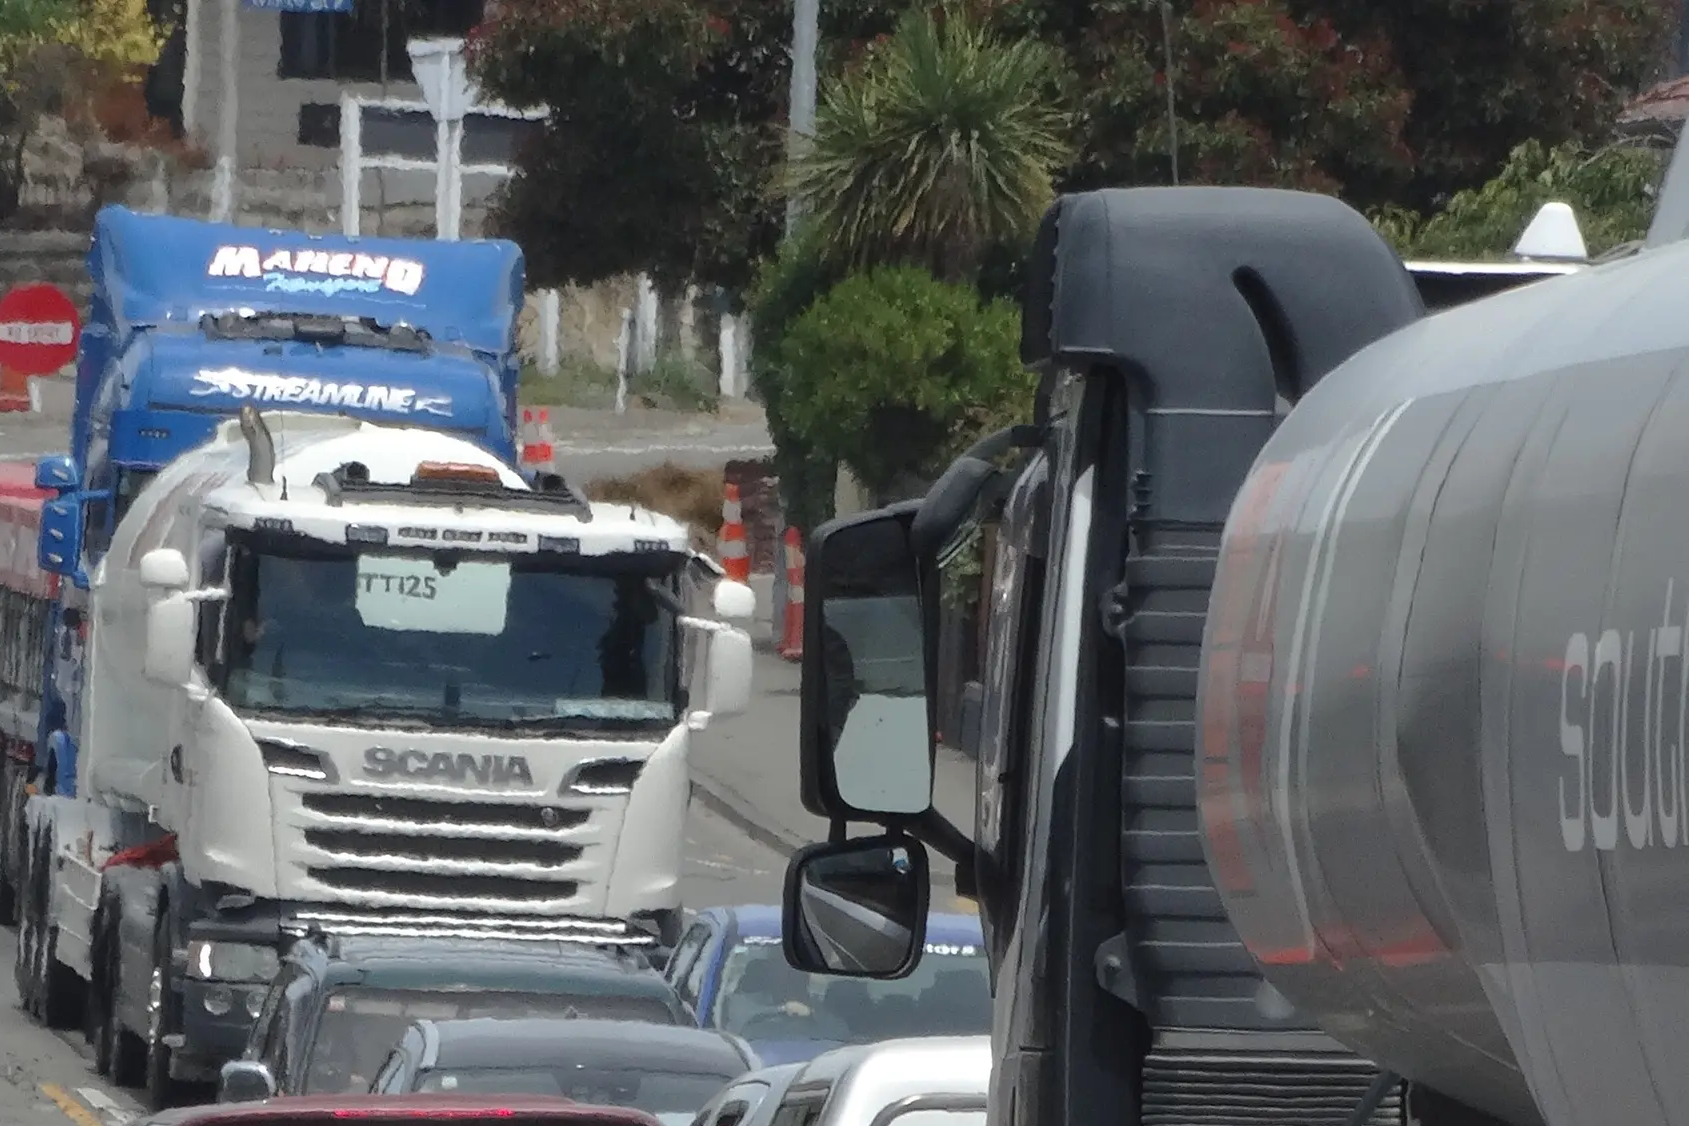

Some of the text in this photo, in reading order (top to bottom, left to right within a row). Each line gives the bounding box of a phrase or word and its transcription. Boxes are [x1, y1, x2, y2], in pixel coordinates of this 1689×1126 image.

[208, 246, 425, 295] MAHENO
[216, 367, 417, 414] STREAMLINE
[362, 746, 534, 787] SCANIA
